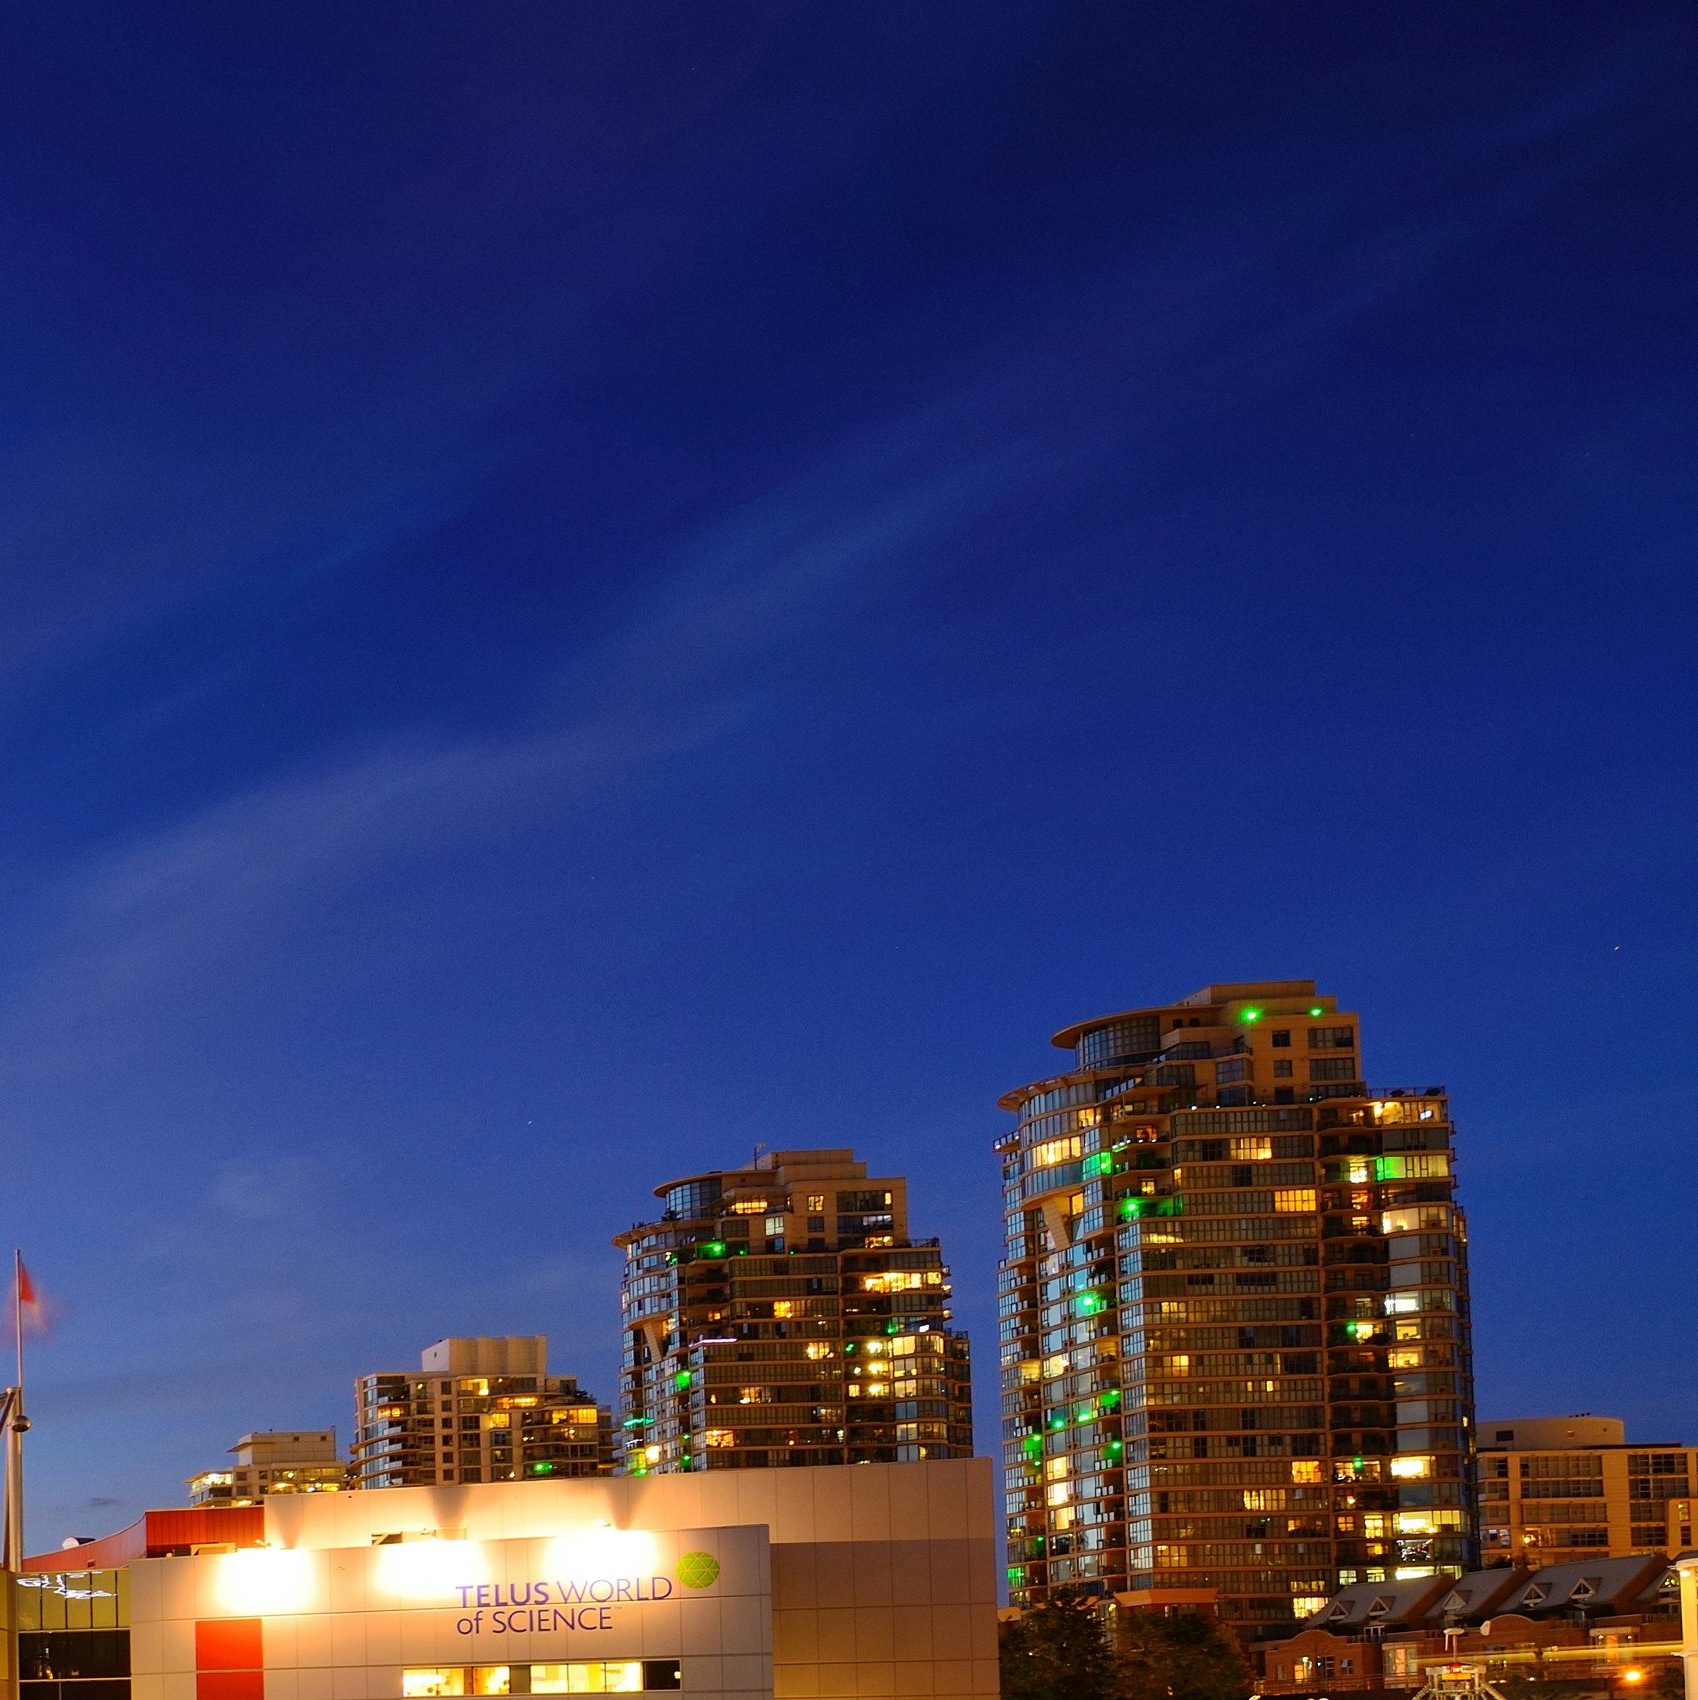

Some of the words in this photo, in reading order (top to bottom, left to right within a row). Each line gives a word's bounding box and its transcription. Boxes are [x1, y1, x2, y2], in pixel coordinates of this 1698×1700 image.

[455, 1581, 550, 1607] TELUS
[556, 1576, 673, 1604] WORLD
[456, 1610, 484, 1635] of
[491, 1606, 614, 1634] SCIENCE
